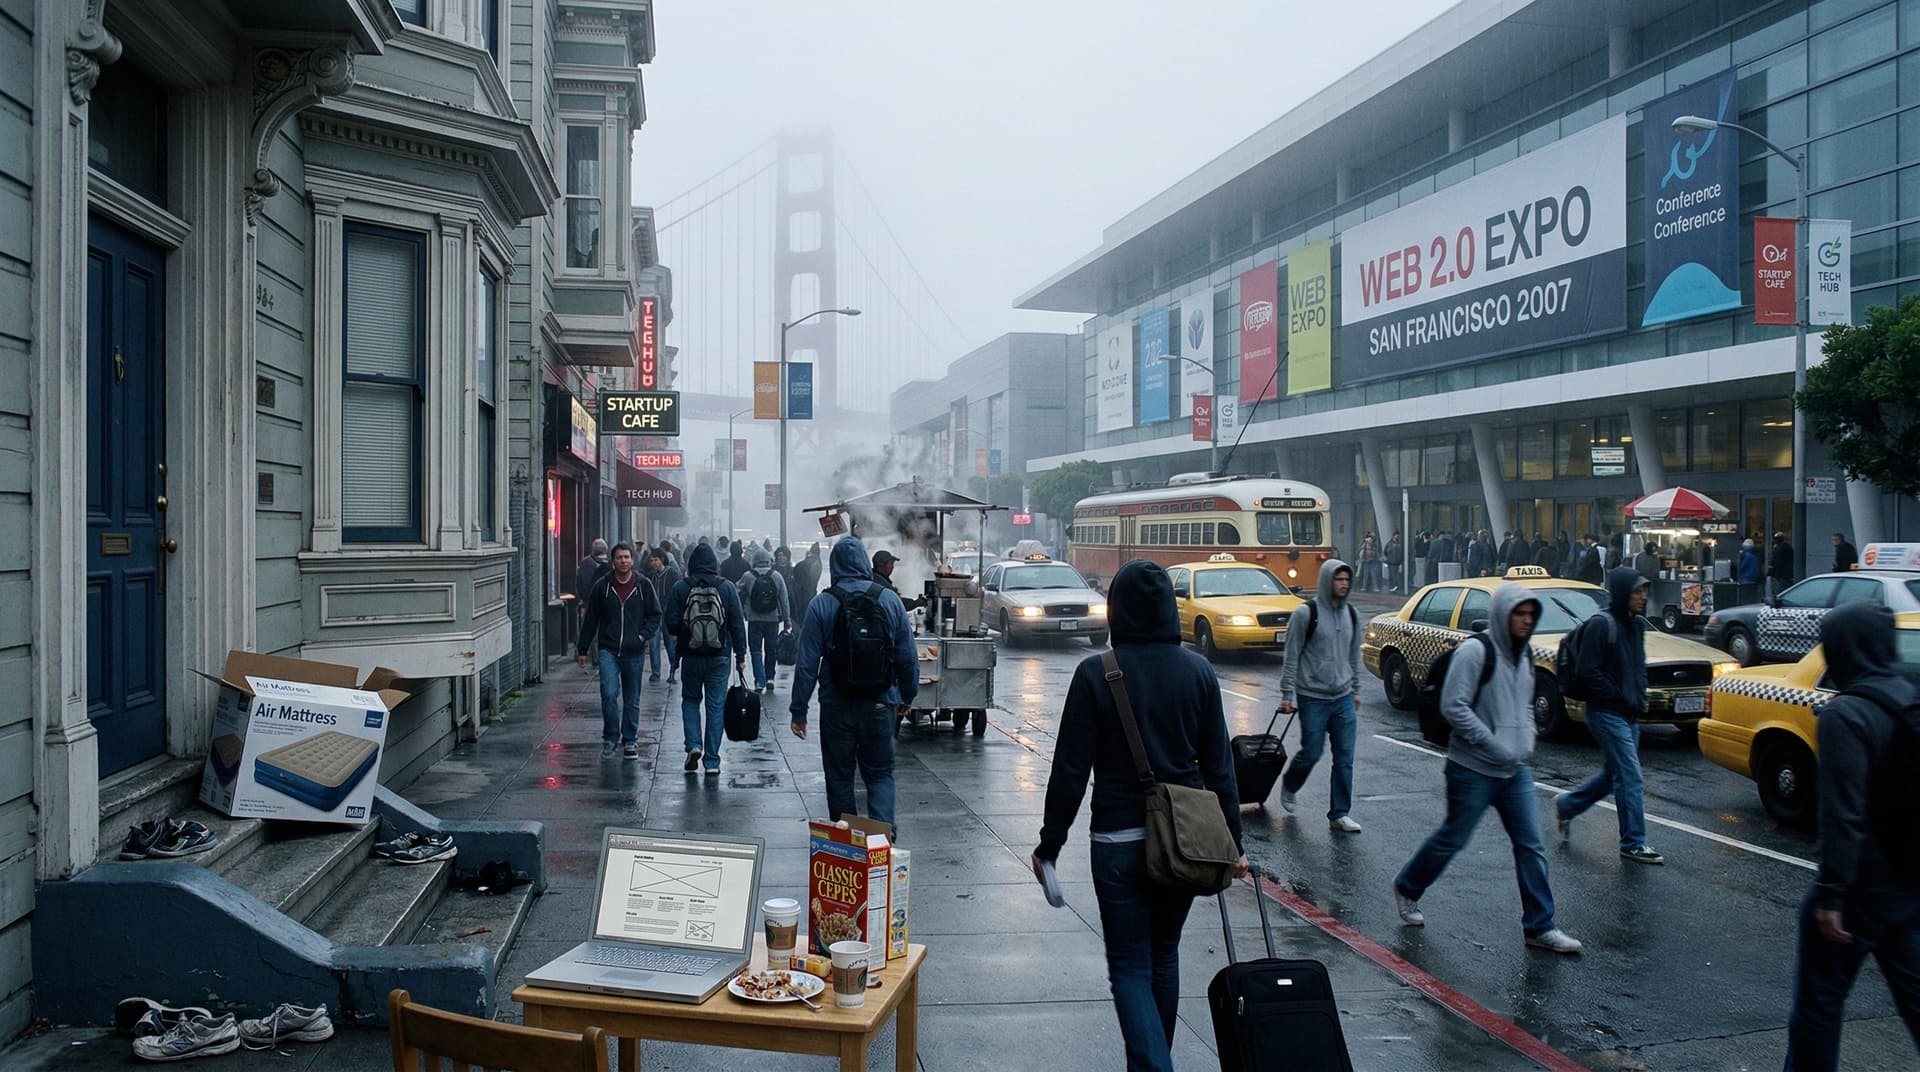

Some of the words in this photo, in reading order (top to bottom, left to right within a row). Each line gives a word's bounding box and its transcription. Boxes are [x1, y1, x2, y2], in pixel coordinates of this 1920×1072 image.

[1656, 183, 1722, 216] Conference
[1654, 207, 1726, 240] Conference
[1359, 245, 1423, 308] WEB
[1430, 225, 1476, 289] 2.0
[1485, 185, 1592, 272] EXPO
[1758, 269, 1792, 279] STARTUP
[1818, 271, 1842, 282] TECH
[1765, 279, 1785, 289] CAFE
[1820, 282, 1840, 293] HUB
[1290, 274, 1326, 311] WEB
[1291, 306, 1326, 335] EXPO
[1369, 322, 1401, 356] SAN
[1405, 294, 1511, 348] FRANCISCO
[1516, 277, 1573, 322] 2007
[606, 397, 674, 412] STARTUP
[622, 414, 660, 428] CAFE
[635, 455, 660, 466] TECH
[662, 455, 681, 466] HUB
[625, 489, 650, 499] TECH
[652, 489, 673, 499] HUB
[1515, 567, 1543, 576] TAXIS
[255, 702, 277, 719] Air
[279, 705, 337, 726] Mattress
[813, 860, 864, 890] CLASSIC
